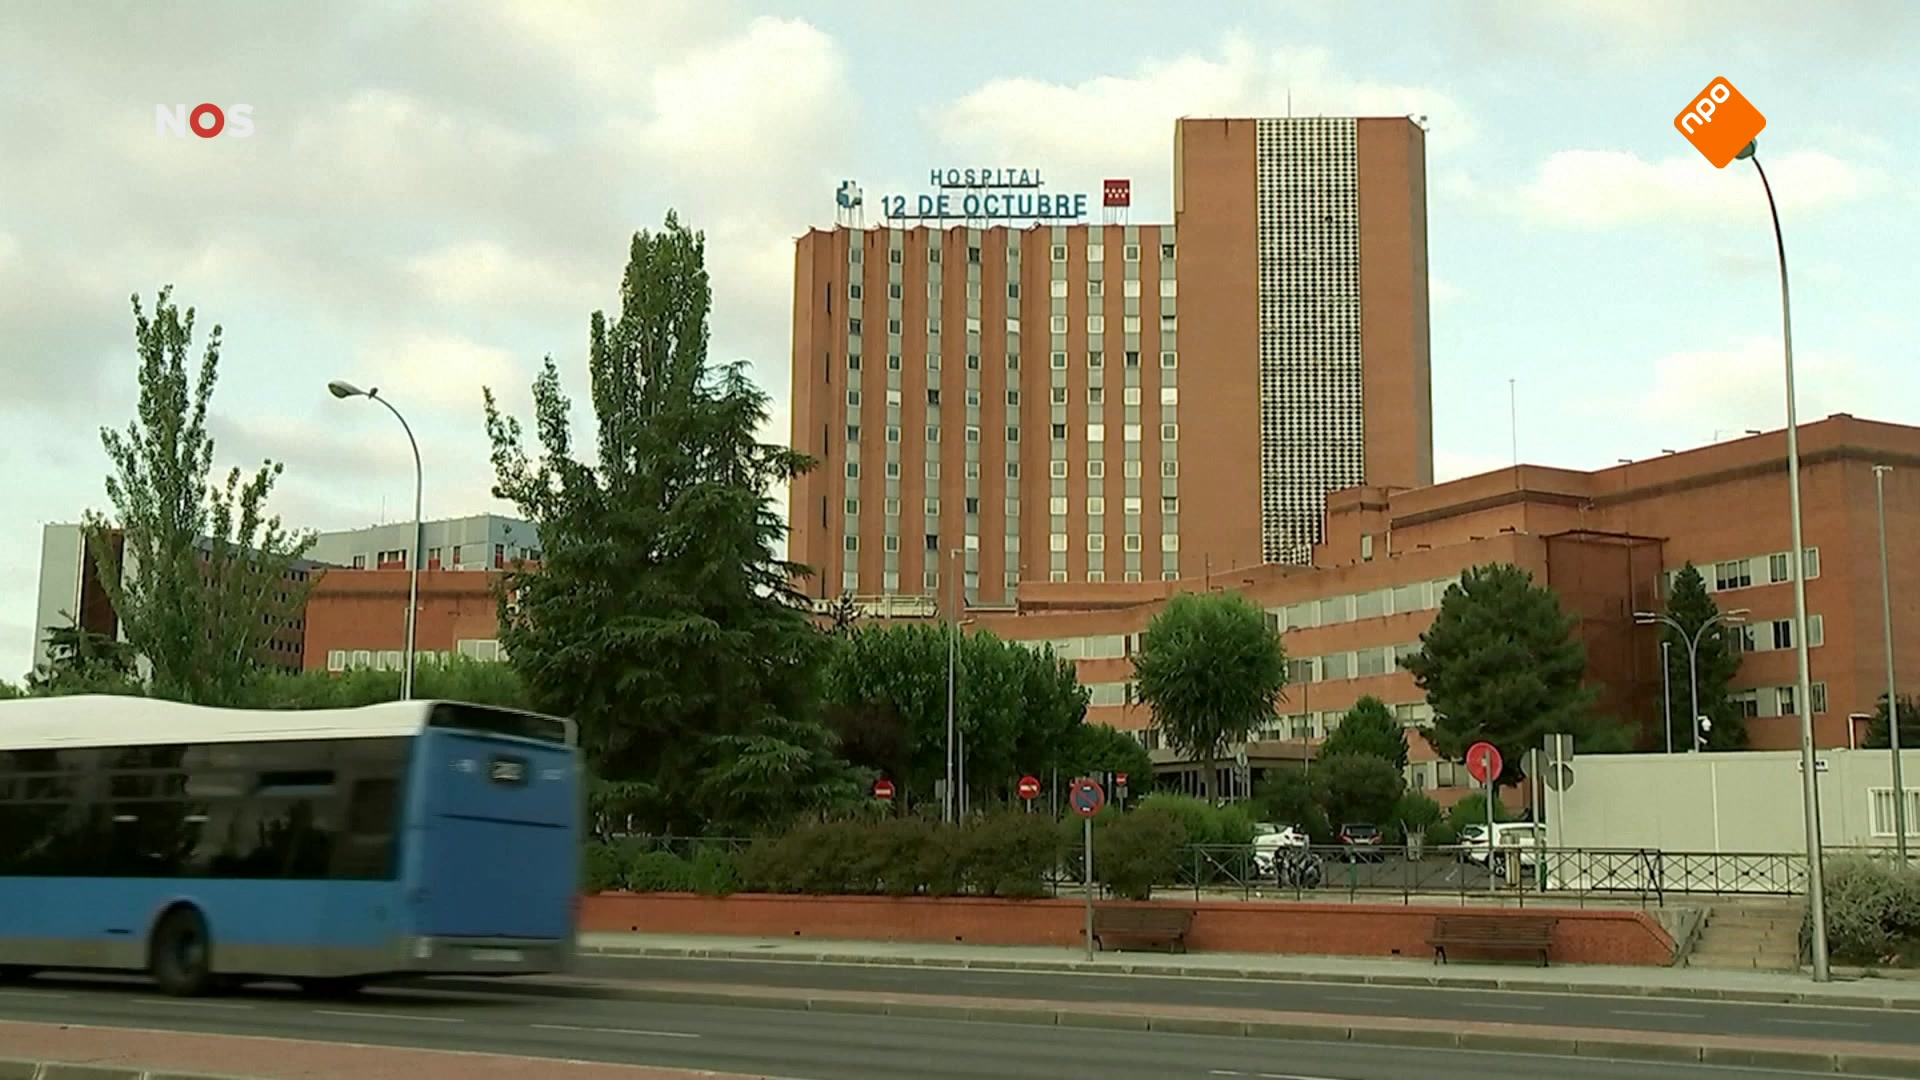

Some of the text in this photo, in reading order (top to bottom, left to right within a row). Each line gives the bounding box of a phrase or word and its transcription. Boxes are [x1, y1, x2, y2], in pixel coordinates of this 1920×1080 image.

[930, 168, 1045, 186] HOSPITAL
[881, 194, 1087, 217] 12 DE OCTUBRE
